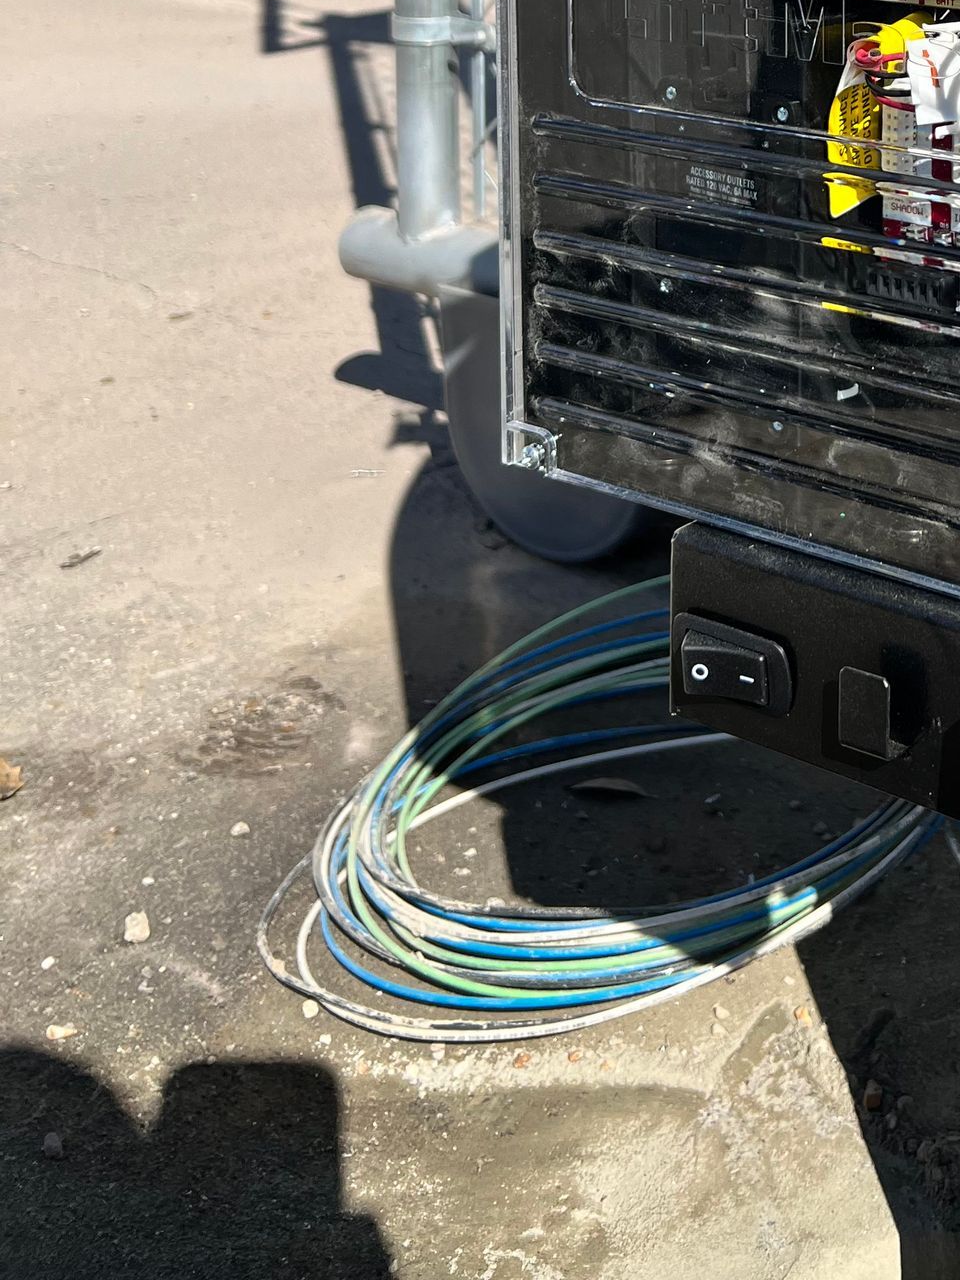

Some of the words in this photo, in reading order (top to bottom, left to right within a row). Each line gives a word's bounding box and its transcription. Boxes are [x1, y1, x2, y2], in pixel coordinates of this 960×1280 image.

[686, 175, 705, 188] RATED
[690, 166, 726, 182] ACCESSORY
[727, 174, 755, 190] OUTLETS
[891, 202, 924, 216] SHADOW
